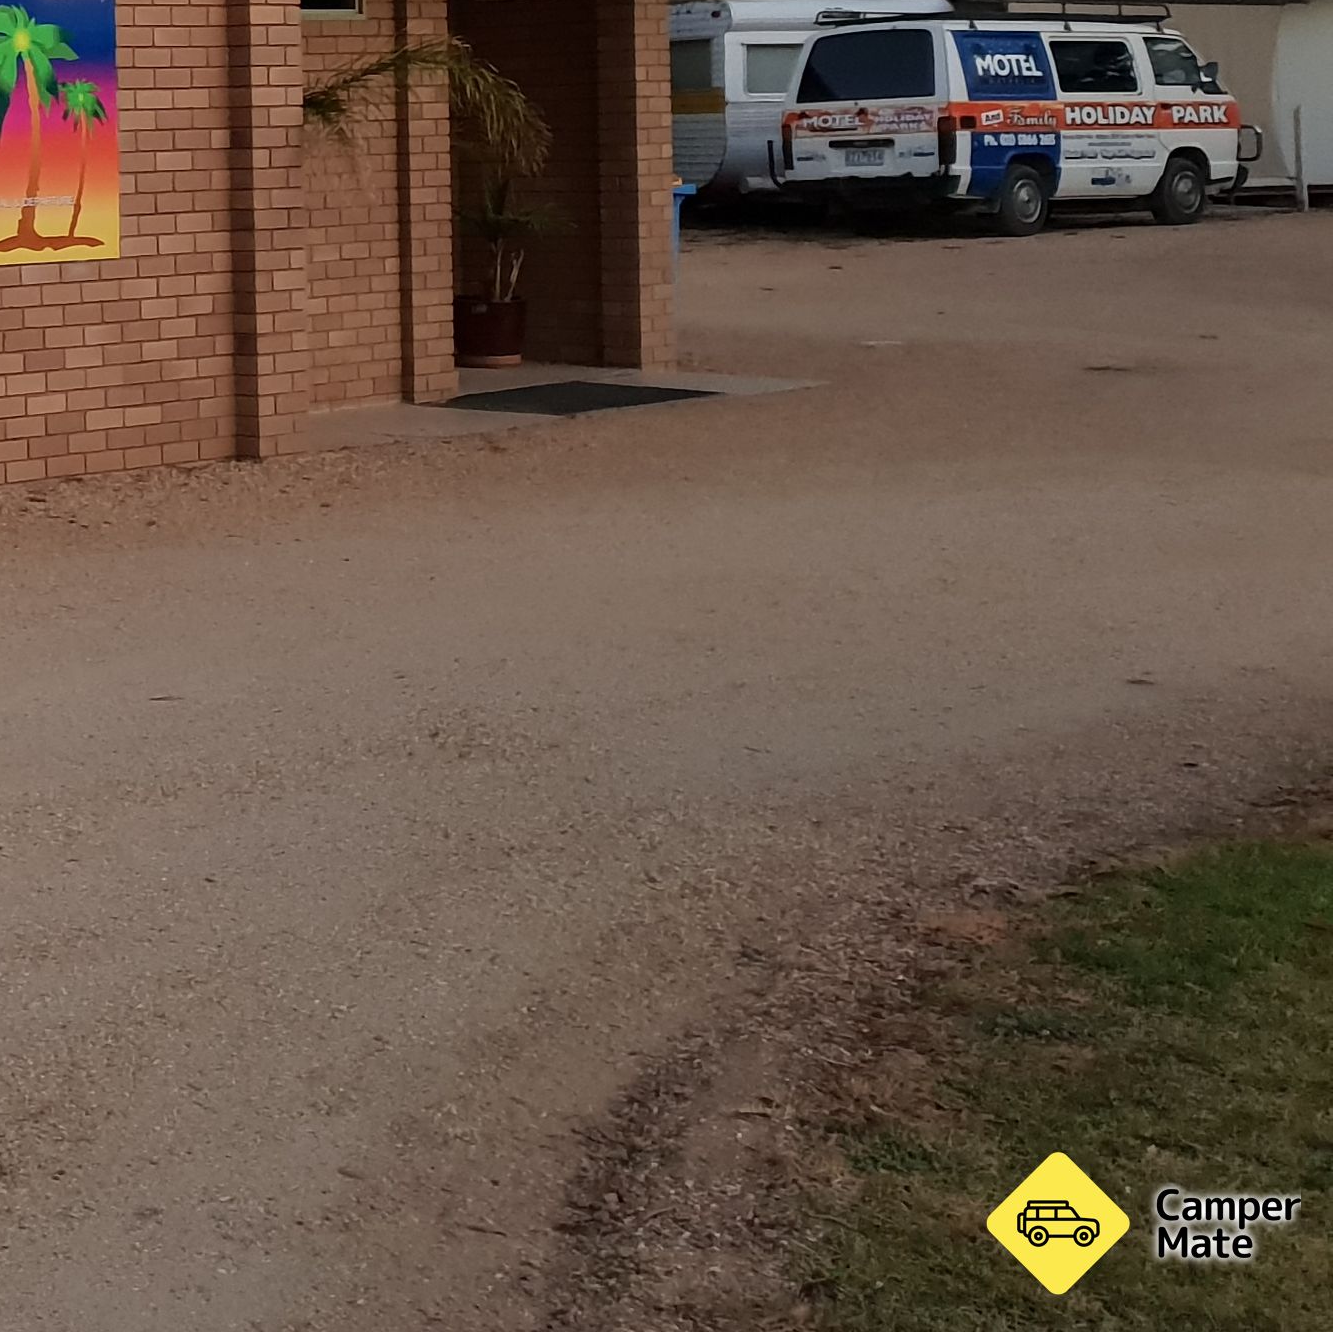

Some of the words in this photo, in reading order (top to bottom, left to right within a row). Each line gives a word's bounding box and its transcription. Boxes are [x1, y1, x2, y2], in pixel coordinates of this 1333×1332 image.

[974, 54, 1043, 77] MOTEL
[803, 114, 865, 128] MOTEL
[985, 113, 1001, 123] And
[1007, 108, 1057, 128] Family
[1065, 106, 1156, 125] HOLIDAY
[1172, 105, 1229, 124] PARK
